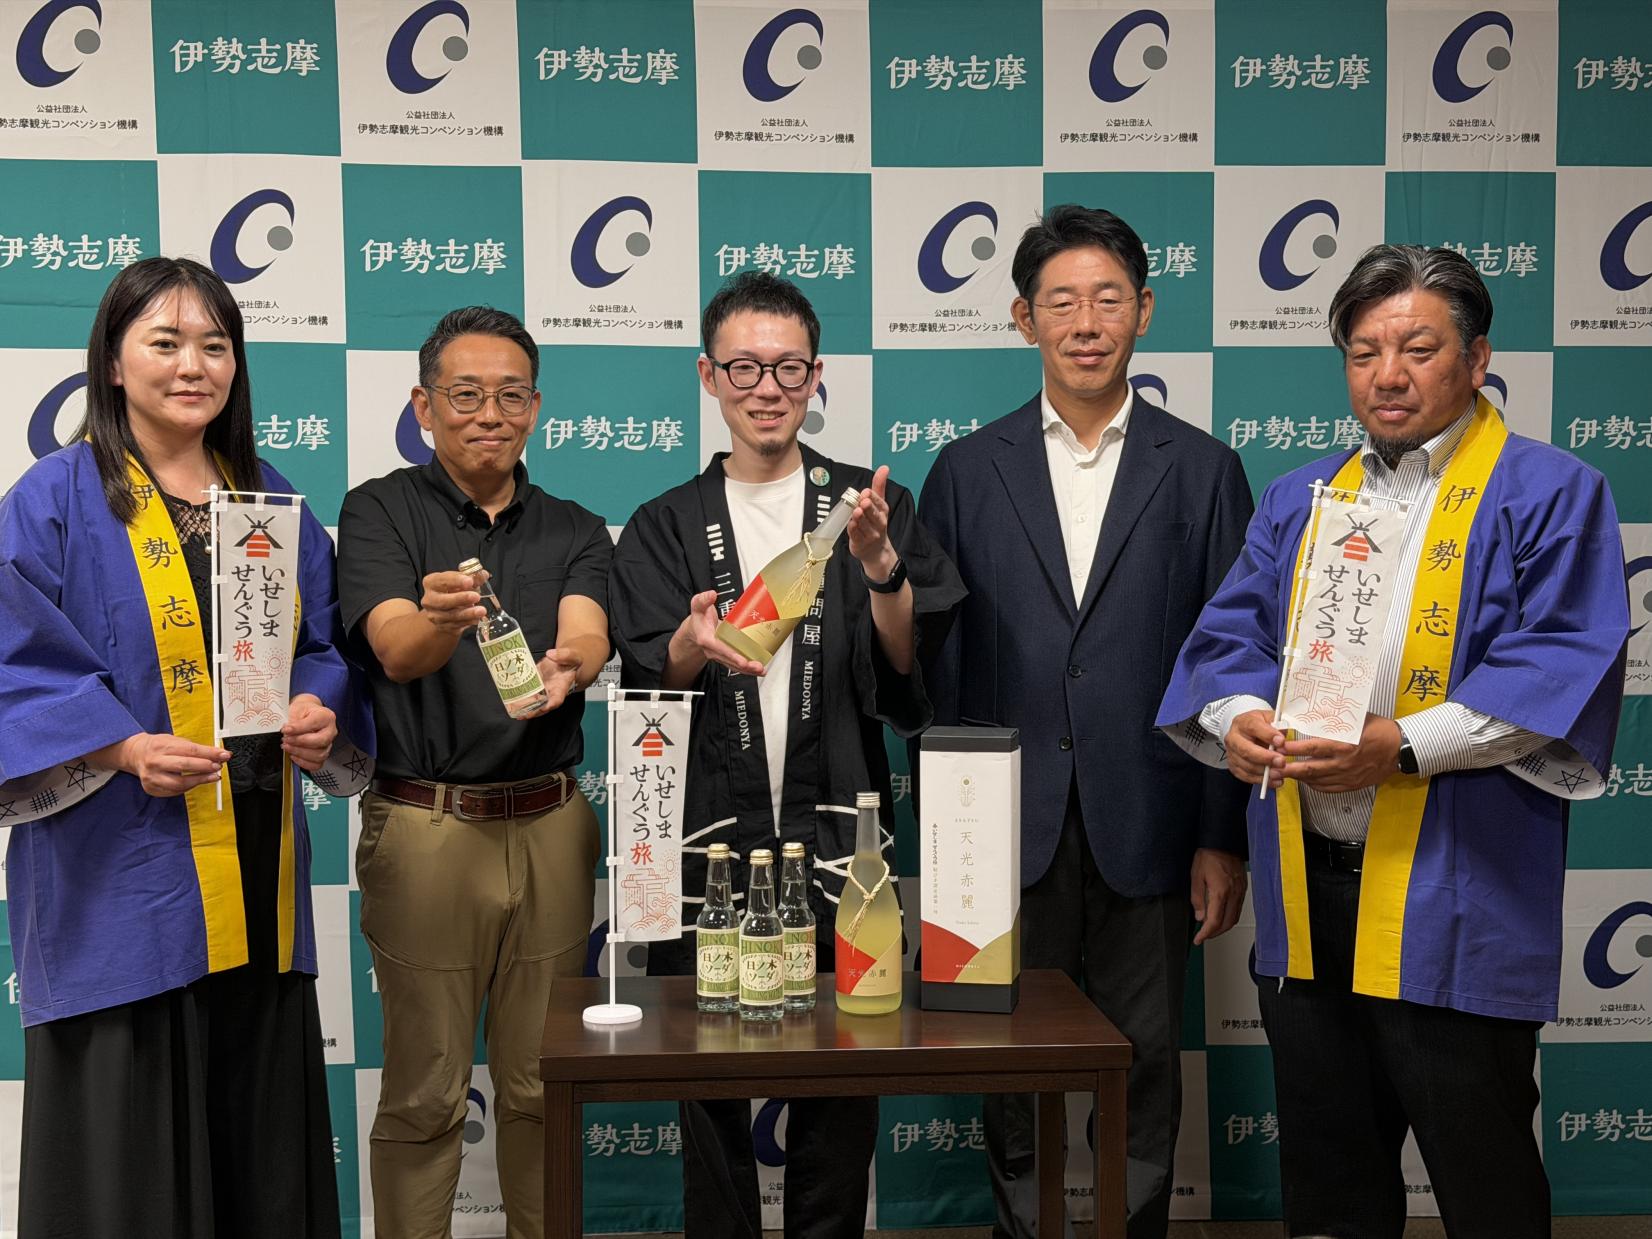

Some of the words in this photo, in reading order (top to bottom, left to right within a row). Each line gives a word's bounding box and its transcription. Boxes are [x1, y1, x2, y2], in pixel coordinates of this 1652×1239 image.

[169, 36, 321, 77] 伊勢志摩
[534, 45, 680, 86] 伊勢志摩
[885, 53, 1027, 91] 伊勢志摩
[1230, 53, 1371, 90] 伊勢志摩
[1573, 56, 1652, 90] 伊勢
[36, 104, 87, 114] 公益社団法人
[405, 110, 456, 120] 公益社団法人
[760, 118, 808, 127] 公益社団法人
[1105, 118, 1153, 127] 公益社団法人
[1448, 118, 1496, 128] 公益社団法人
[357, 122, 504, 137] 伊勢志摩観光コンベンション機構
[714, 130, 855, 144] 伊勢志摩観光コンベンション機構
[1059, 132, 1198, 143] 伊勢志摩観光コンベンション機構
[1402, 132, 1540, 144] 伊勢志摩観光コンベンション機構
[0, 234, 143, 270] 伊勢志摩
[359, 238, 507, 275] 伊勢志摩
[714, 243, 857, 280] 伊勢志摩
[541, 317, 684, 330] 伊勢志摩観光コンベンション機構
[588, 304, 636, 313] 公益社団法人
[934, 308, 981, 318] 公益社団法人
[1275, 306, 1321, 315] 公益社団法人
[541, 415, 684, 452] 伊勢志摩
[1226, 415, 1364, 450] 伊勢志摩
[130, 483, 205, 694] 伊勢志摩
[259, 564, 286, 638] いせしま
[1402, 484, 1478, 701] 伊勢志摩
[231, 564, 257, 662] せんぐう旅
[1307, 564, 1350, 663] せんぐう旅
[1345, 568, 1382, 647] いせしま
[801, 660, 814, 720] MIEDONYA
[734, 690, 751, 750] MIEDONYA
[629, 764, 654, 866] せんぐう旅
[653, 764, 676, 840] いせしま
[704, 951, 733, 963] 日ノ木
[705, 963, 731, 974] ソーダ
[747, 959, 778, 971] 日ノ木
[786, 961, 812, 973] ソーダ
[748, 970, 776, 982] ソーダ
[1599, 1003, 1645, 1012] 公益社団法人
